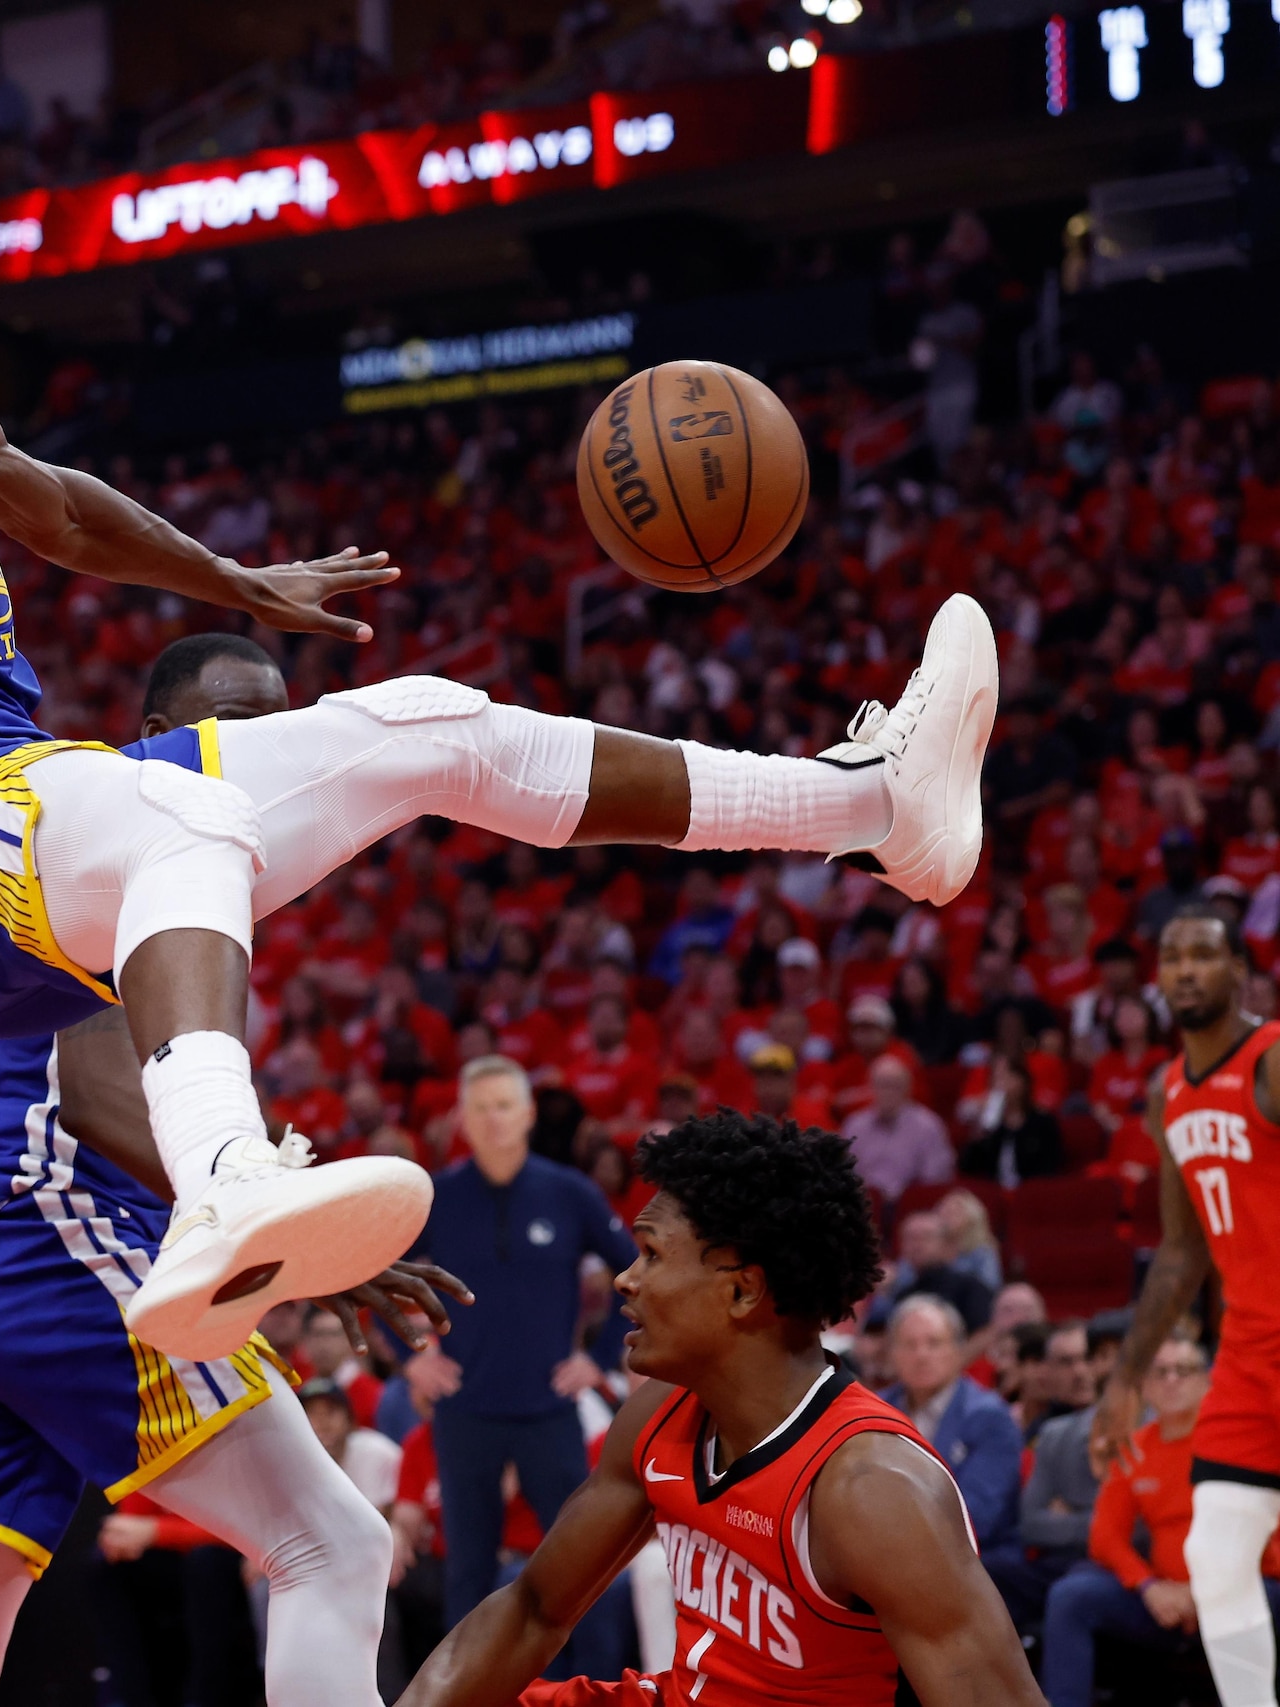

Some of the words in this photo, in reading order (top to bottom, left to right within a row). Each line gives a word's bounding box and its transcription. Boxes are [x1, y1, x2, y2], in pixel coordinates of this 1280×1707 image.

[418, 126, 592, 188] ALWAYS
[614, 112, 674, 157] US
[112, 166, 297, 243] LIFTOFF
[603, 381, 659, 532] Wilson
[1195, 1166, 1234, 1236] 17
